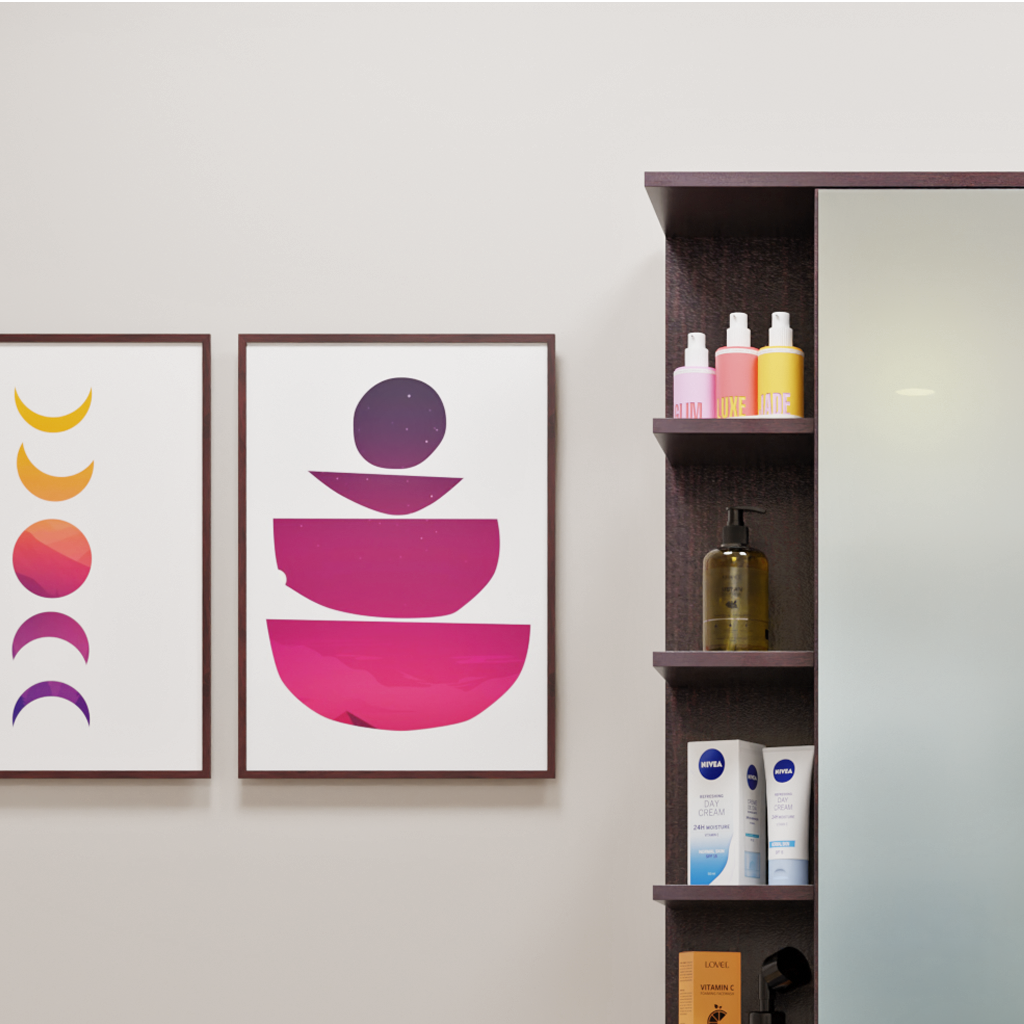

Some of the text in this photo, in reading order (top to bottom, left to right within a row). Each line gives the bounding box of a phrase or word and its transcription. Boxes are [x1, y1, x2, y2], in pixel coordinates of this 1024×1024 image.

[717, 396, 746, 419] LUXE
[759, 393, 791, 416] JADE
[775, 767, 793, 775] NIVEA
[704, 800, 719, 808] DAY
[698, 808, 725, 817] CREAM
